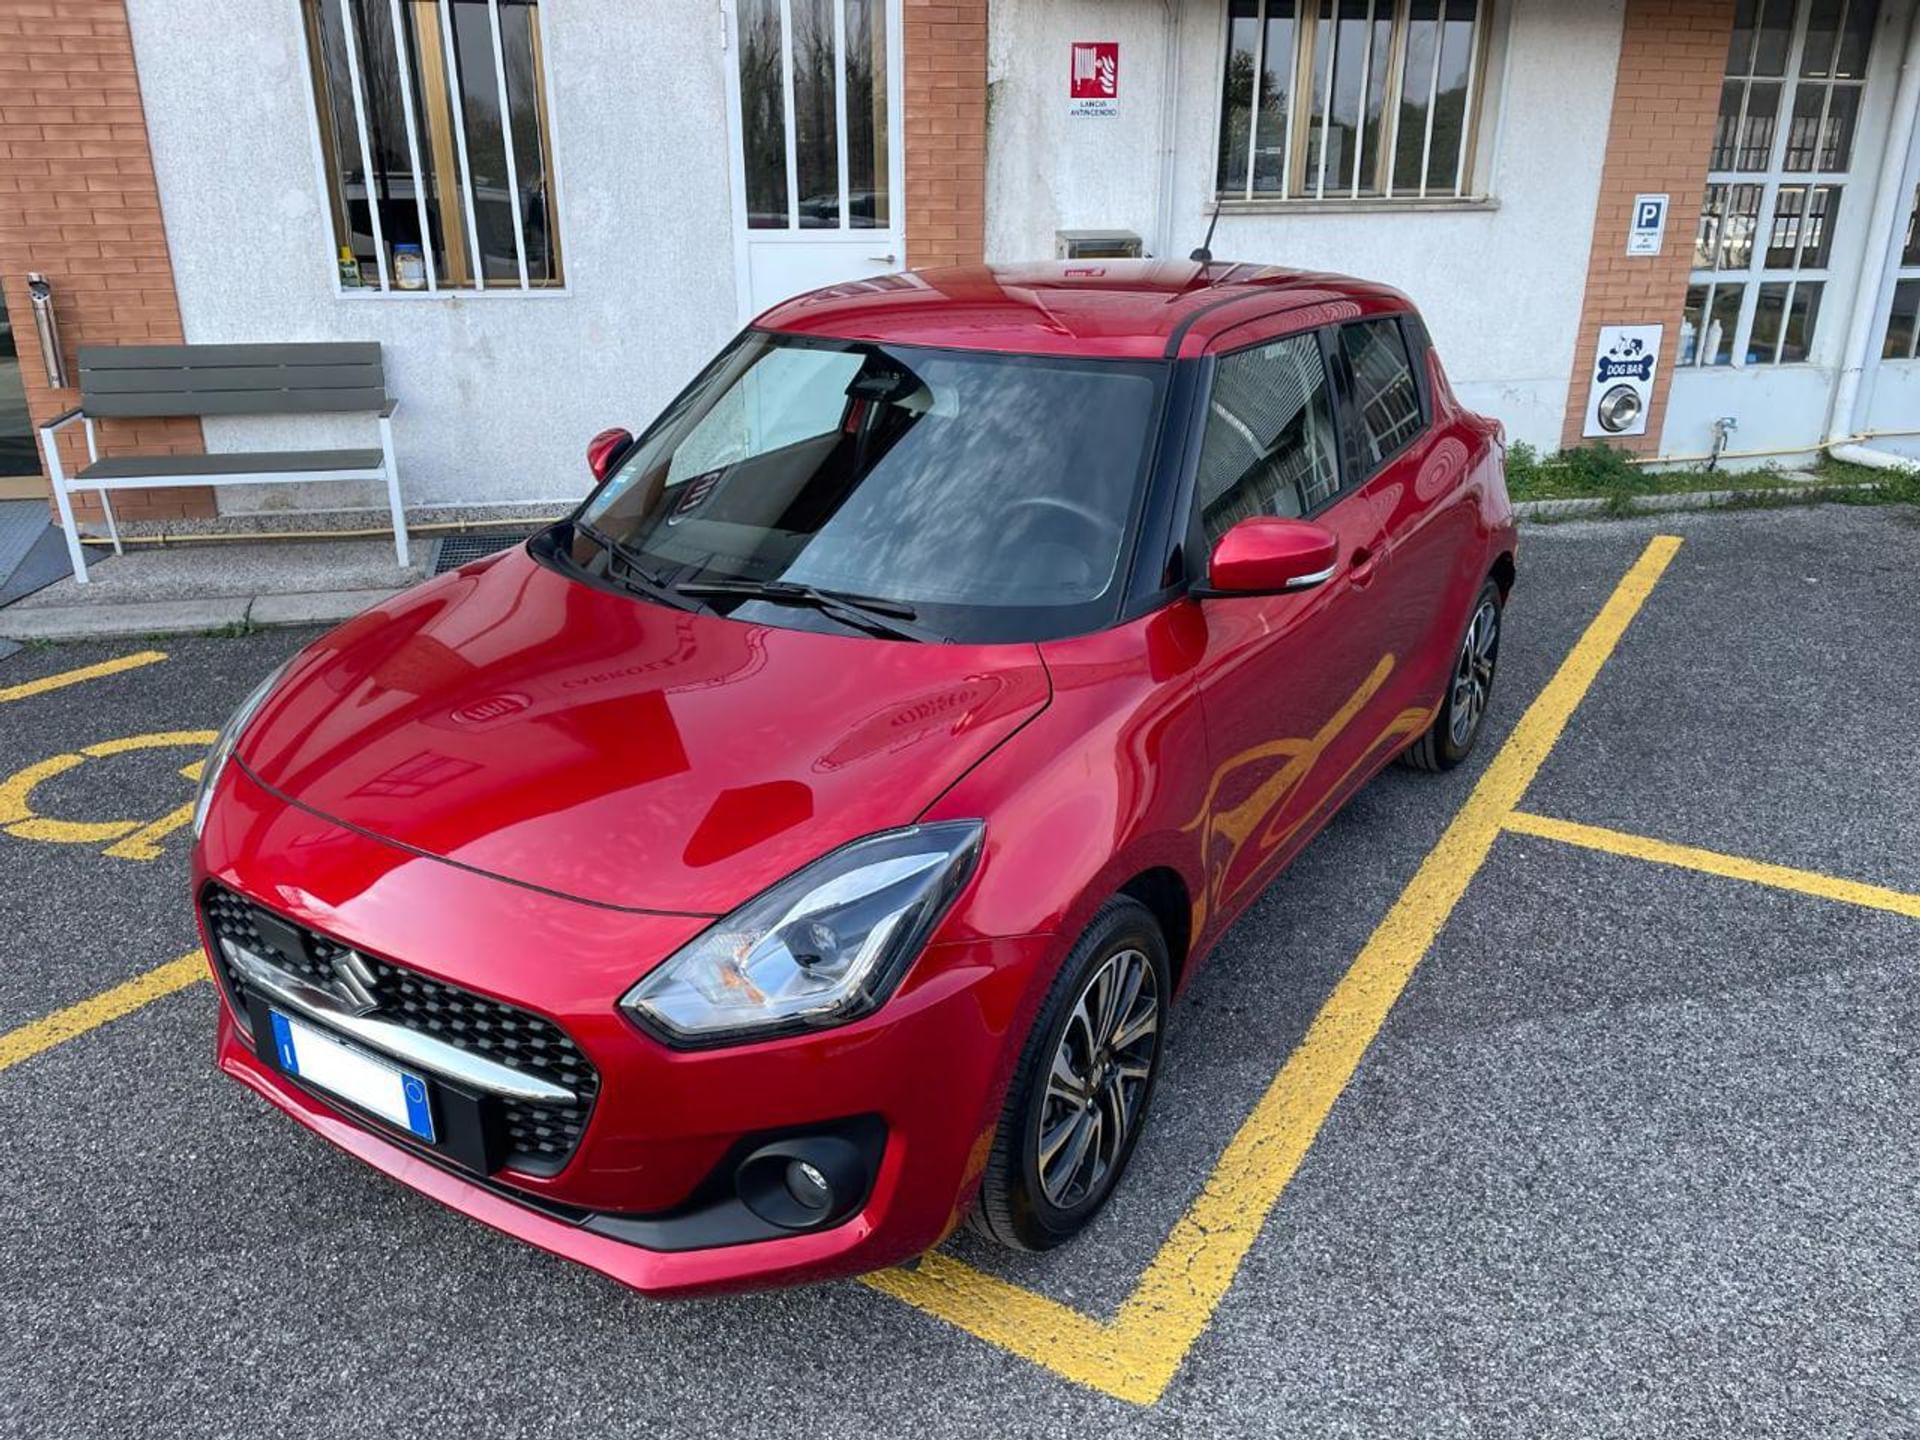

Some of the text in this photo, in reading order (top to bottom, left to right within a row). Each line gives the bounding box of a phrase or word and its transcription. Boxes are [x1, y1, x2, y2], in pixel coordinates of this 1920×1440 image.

[1641, 204, 1657, 227] P
[1606, 363, 1644, 376] DOG BAR
